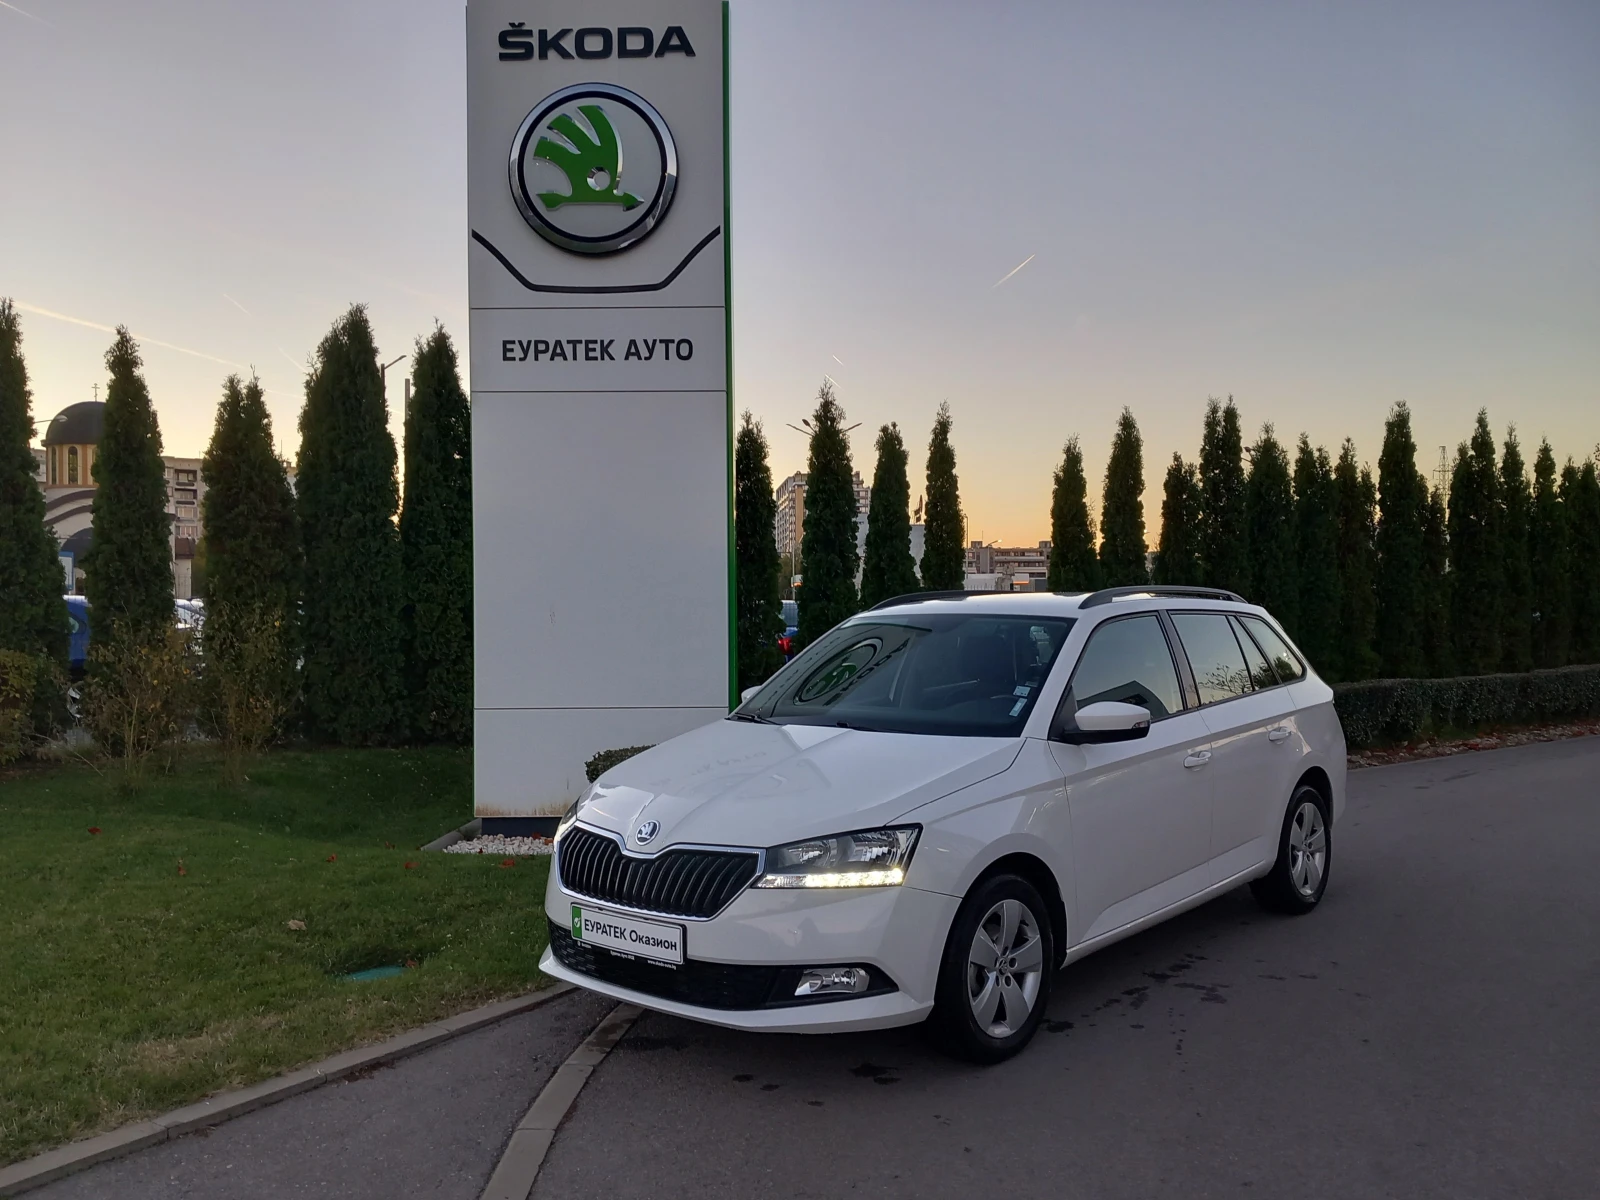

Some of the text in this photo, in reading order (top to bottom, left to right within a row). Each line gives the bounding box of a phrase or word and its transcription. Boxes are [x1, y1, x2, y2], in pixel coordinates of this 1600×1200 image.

[498, 22, 696, 61] ŠKODA
[502, 338, 693, 362] ЕУРАТЕК АУТО
[584, 919, 677, 951] ЕУРАТЕК Оказион
